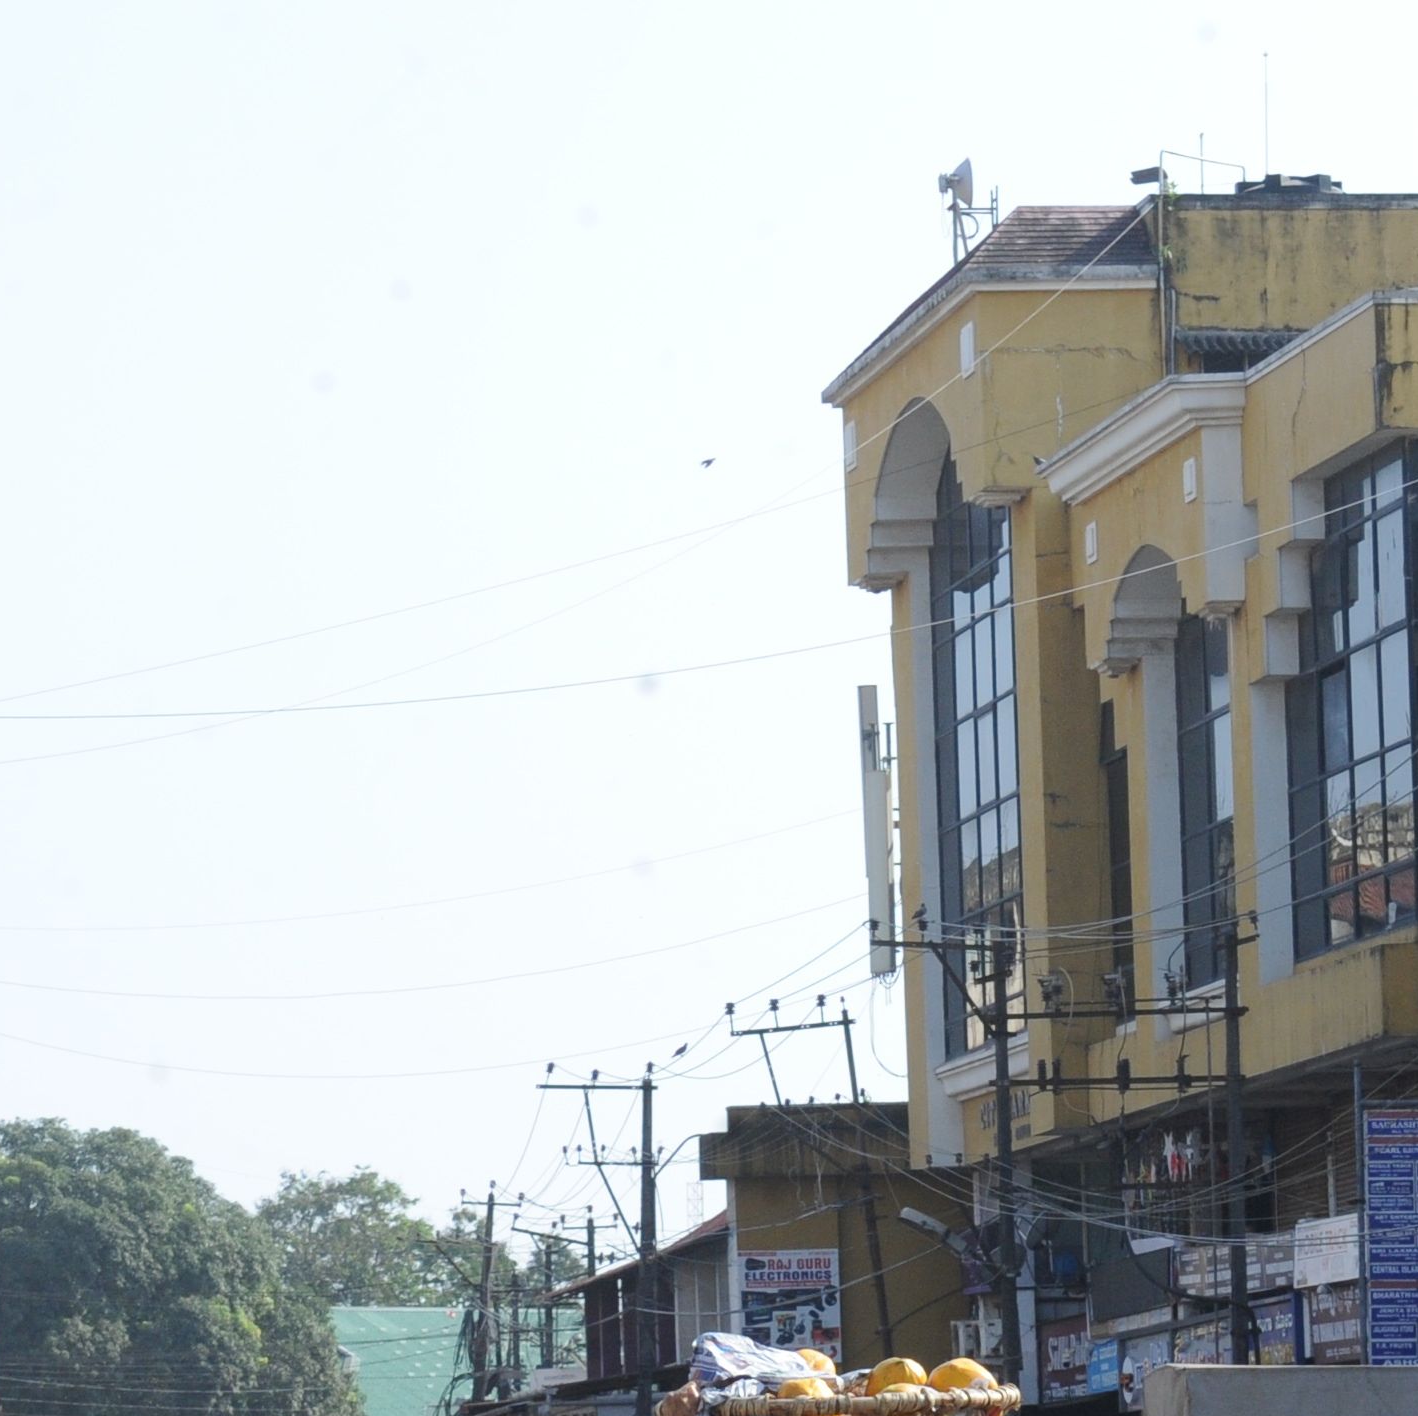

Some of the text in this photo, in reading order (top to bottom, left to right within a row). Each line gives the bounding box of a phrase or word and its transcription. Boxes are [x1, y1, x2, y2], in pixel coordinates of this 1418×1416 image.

[767, 1257, 831, 1271] RAJ GURU
[1372, 1265, 1401, 1274] CENTRAL
[744, 1270, 832, 1281] ELECTRONICS
